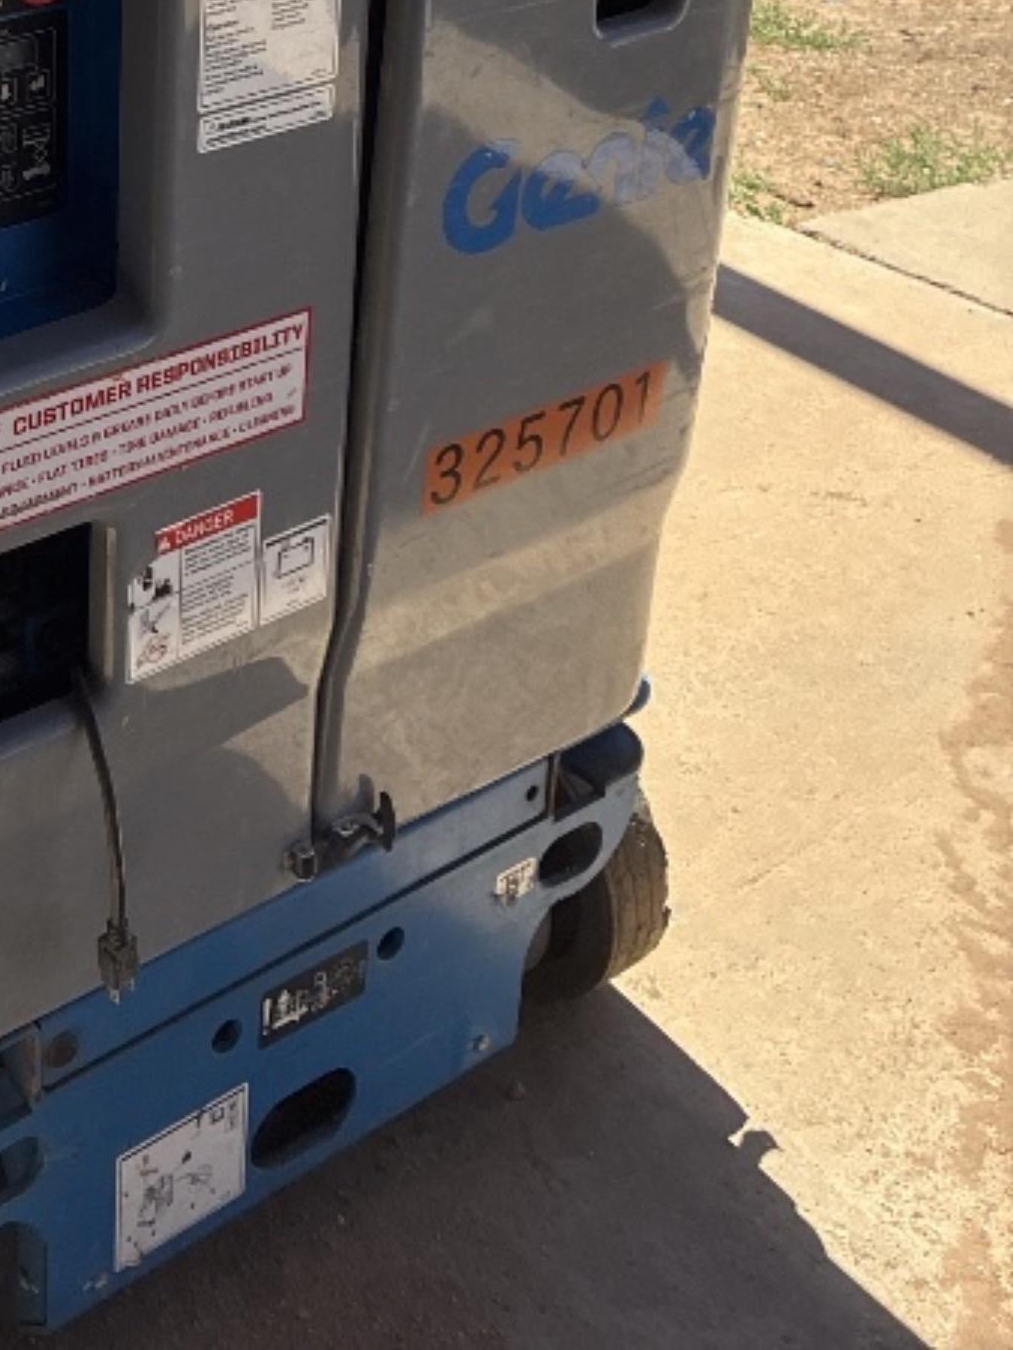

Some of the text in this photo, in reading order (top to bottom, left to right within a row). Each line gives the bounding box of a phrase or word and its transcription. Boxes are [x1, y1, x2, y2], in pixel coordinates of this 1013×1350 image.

[442, 96, 718, 255] Genie
[12, 380, 133, 436] CUSTOMER
[136, 323, 304, 394] RESPONSIBILITY
[430, 371, 652, 506] 325701
[175, 509, 235, 545] DANGER
